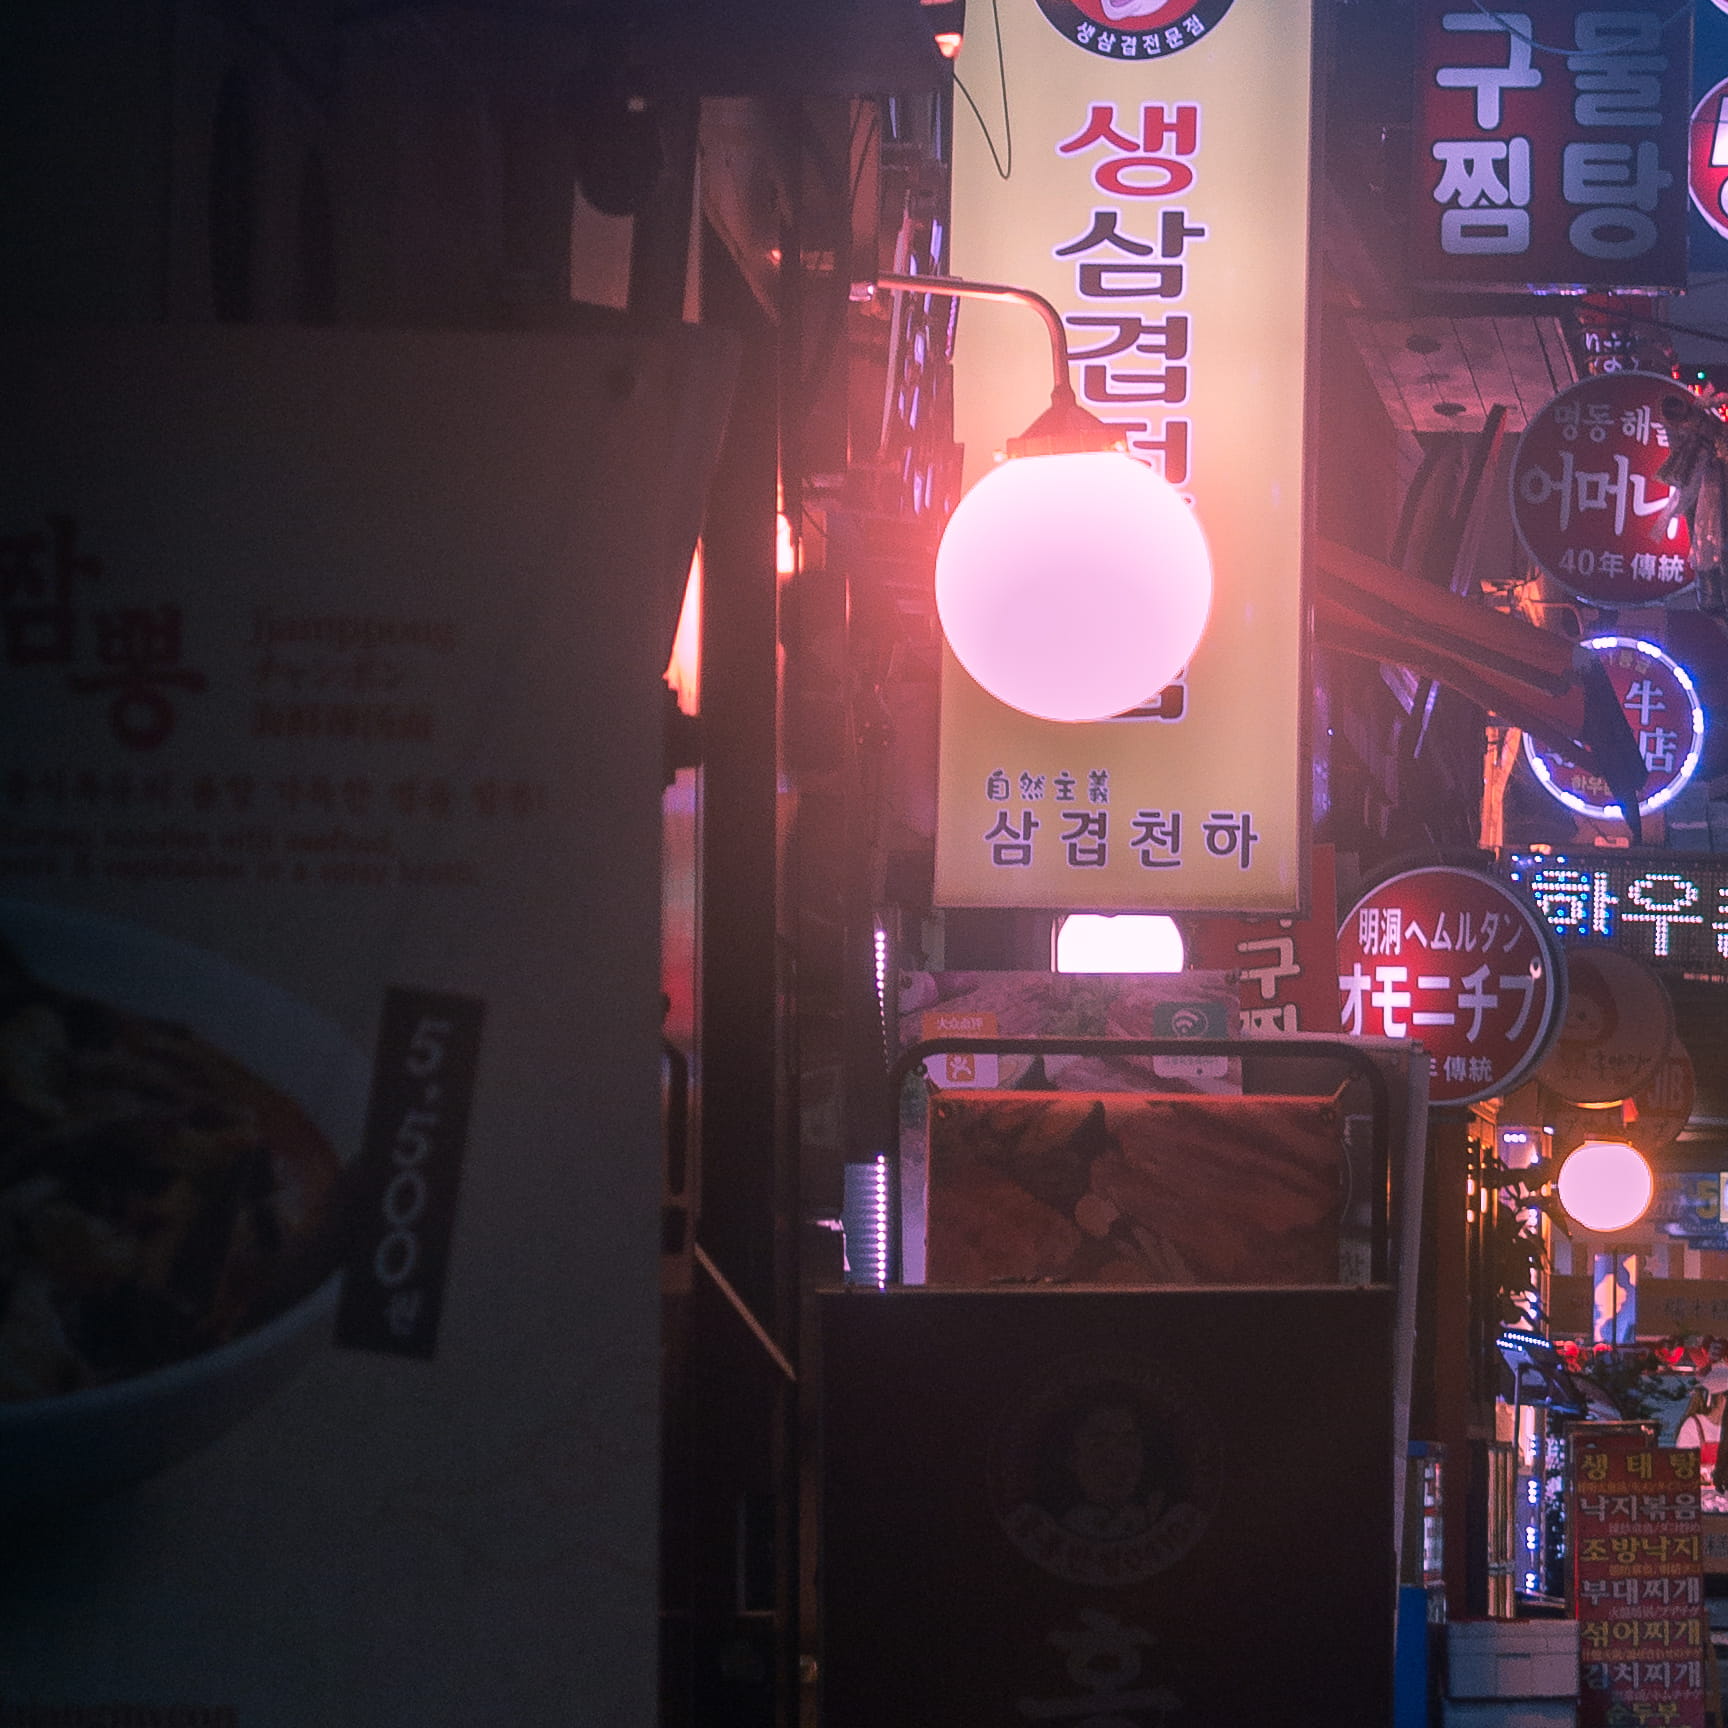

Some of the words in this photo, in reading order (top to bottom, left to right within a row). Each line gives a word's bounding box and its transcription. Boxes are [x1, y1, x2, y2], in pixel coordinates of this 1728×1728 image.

[1558, 548, 1624, 576] 40年
[985, 768, 1111, 805] 自然主義
[982, 808, 1261, 870] 삼겹천하
[1579, 1576, 1701, 1606] 부대찌개
